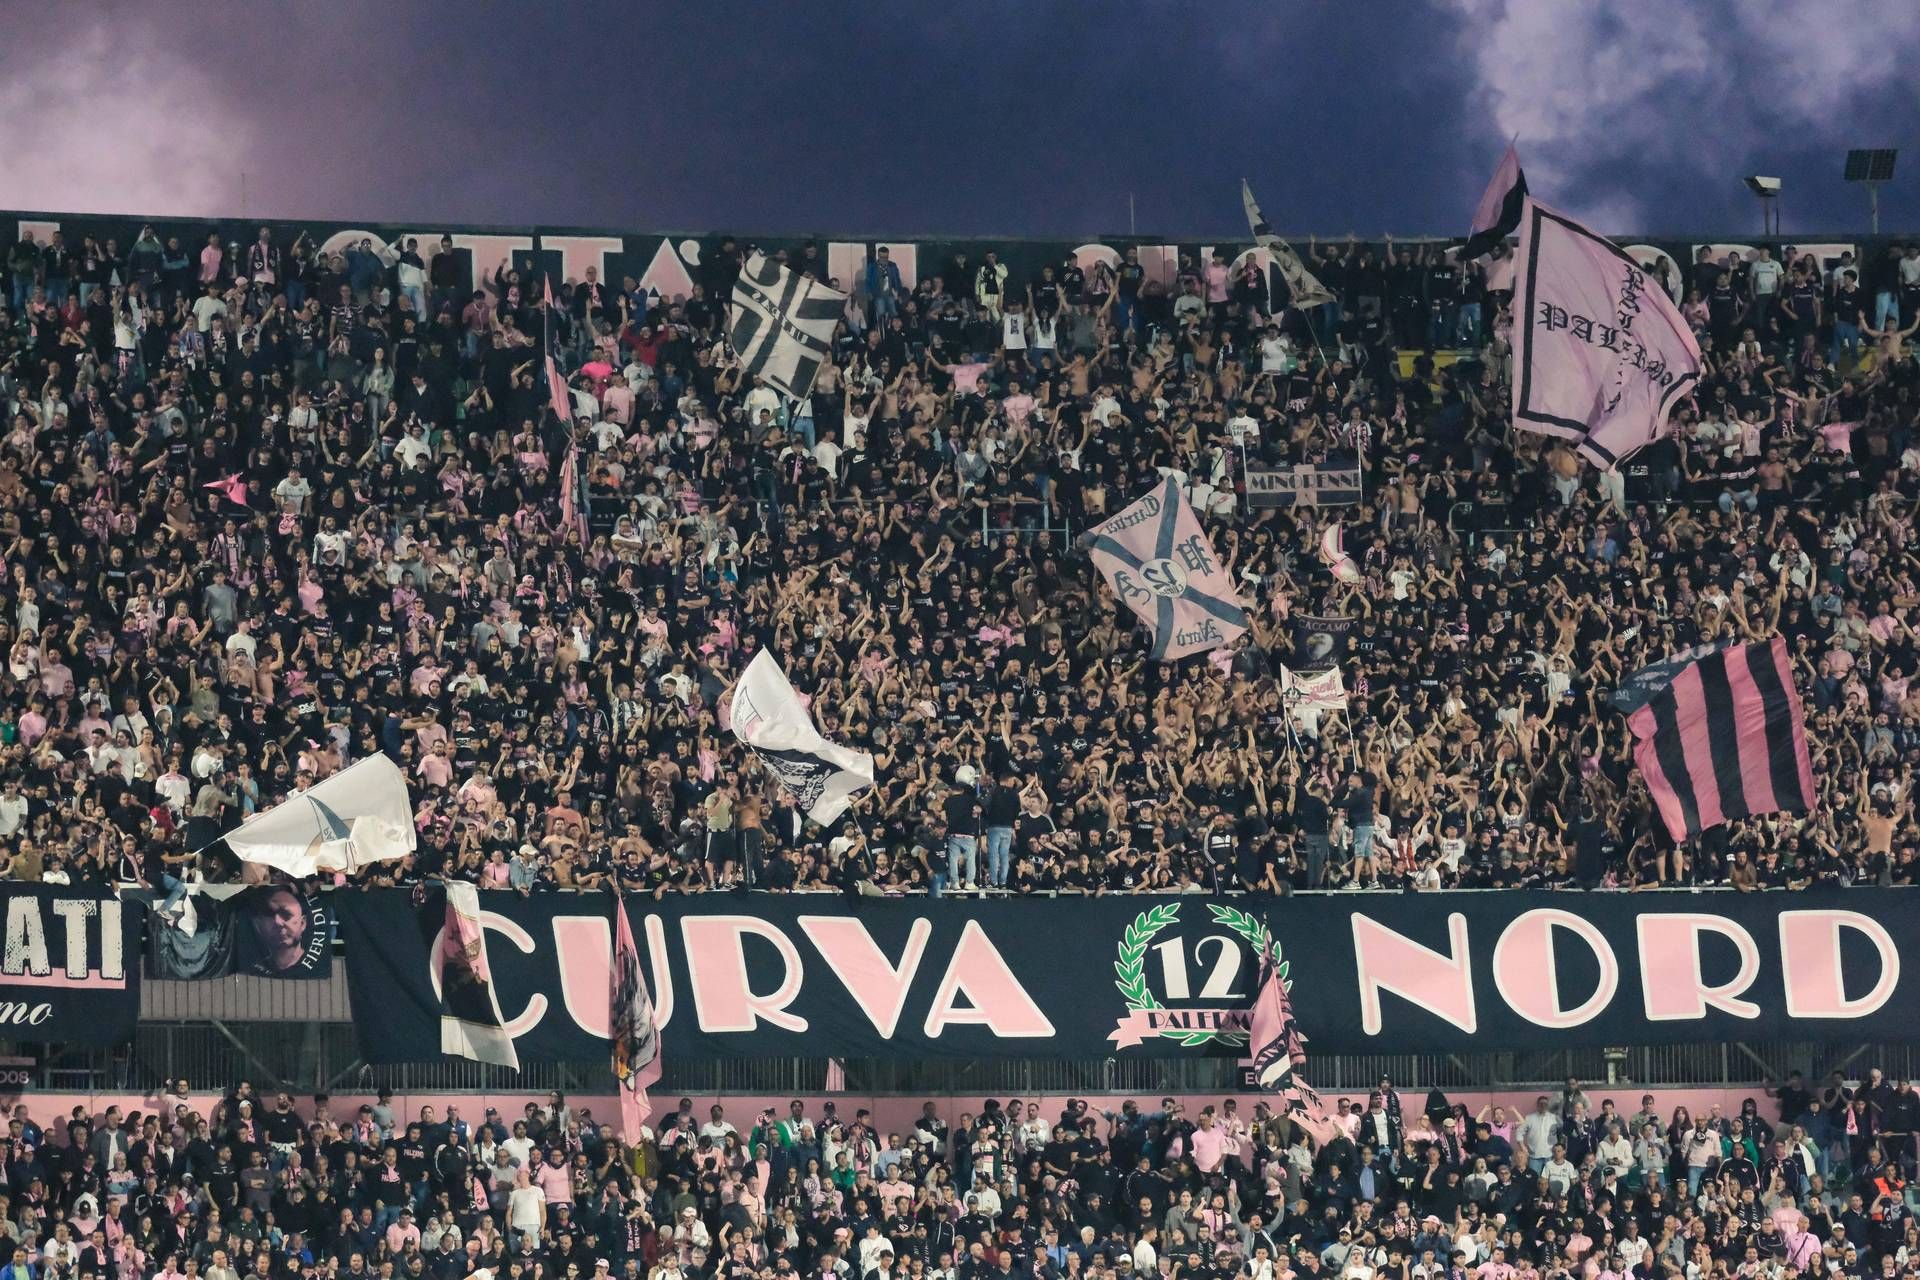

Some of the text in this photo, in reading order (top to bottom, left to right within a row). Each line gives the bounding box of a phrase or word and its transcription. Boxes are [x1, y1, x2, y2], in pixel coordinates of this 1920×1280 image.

[2, 895, 123, 980] ATI
[311, 907, 326, 926] DI
[301, 931, 326, 970] FIERI
[430, 908, 1900, 1040] CURVA NORD
[1152, 935, 1247, 999] 12
[1147, 1011, 1254, 1030] PALERM
